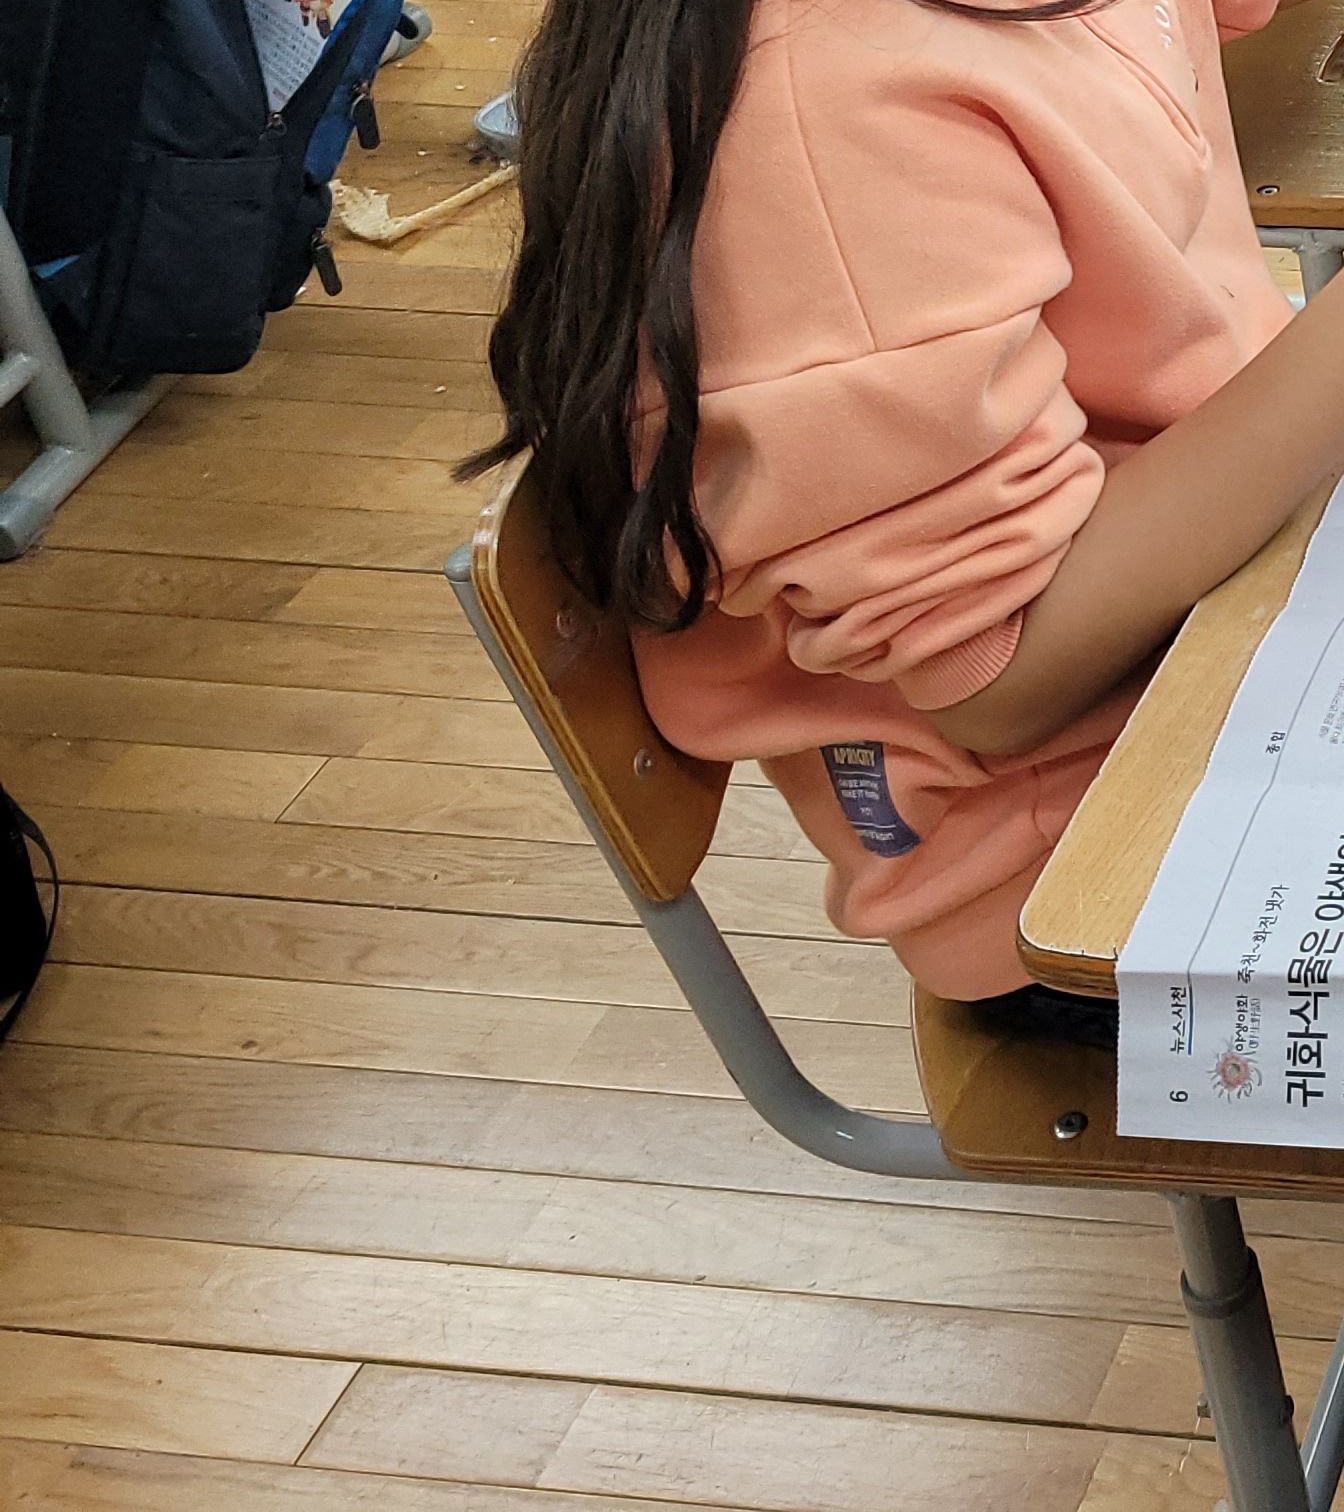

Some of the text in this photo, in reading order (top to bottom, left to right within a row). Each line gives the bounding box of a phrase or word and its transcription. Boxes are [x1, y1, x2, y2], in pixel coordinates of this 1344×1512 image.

[1264, 730, 1286, 756] 종합
[1265, 884, 1290, 912] 냇가
[1170, 986, 1187, 1054] 뉴스사천
[1235, 995, 1248, 1051] 야생야화
[1285, 928, 1342, 1108] 귀화식물은
[1170, 1091, 1188, 1102] 6
